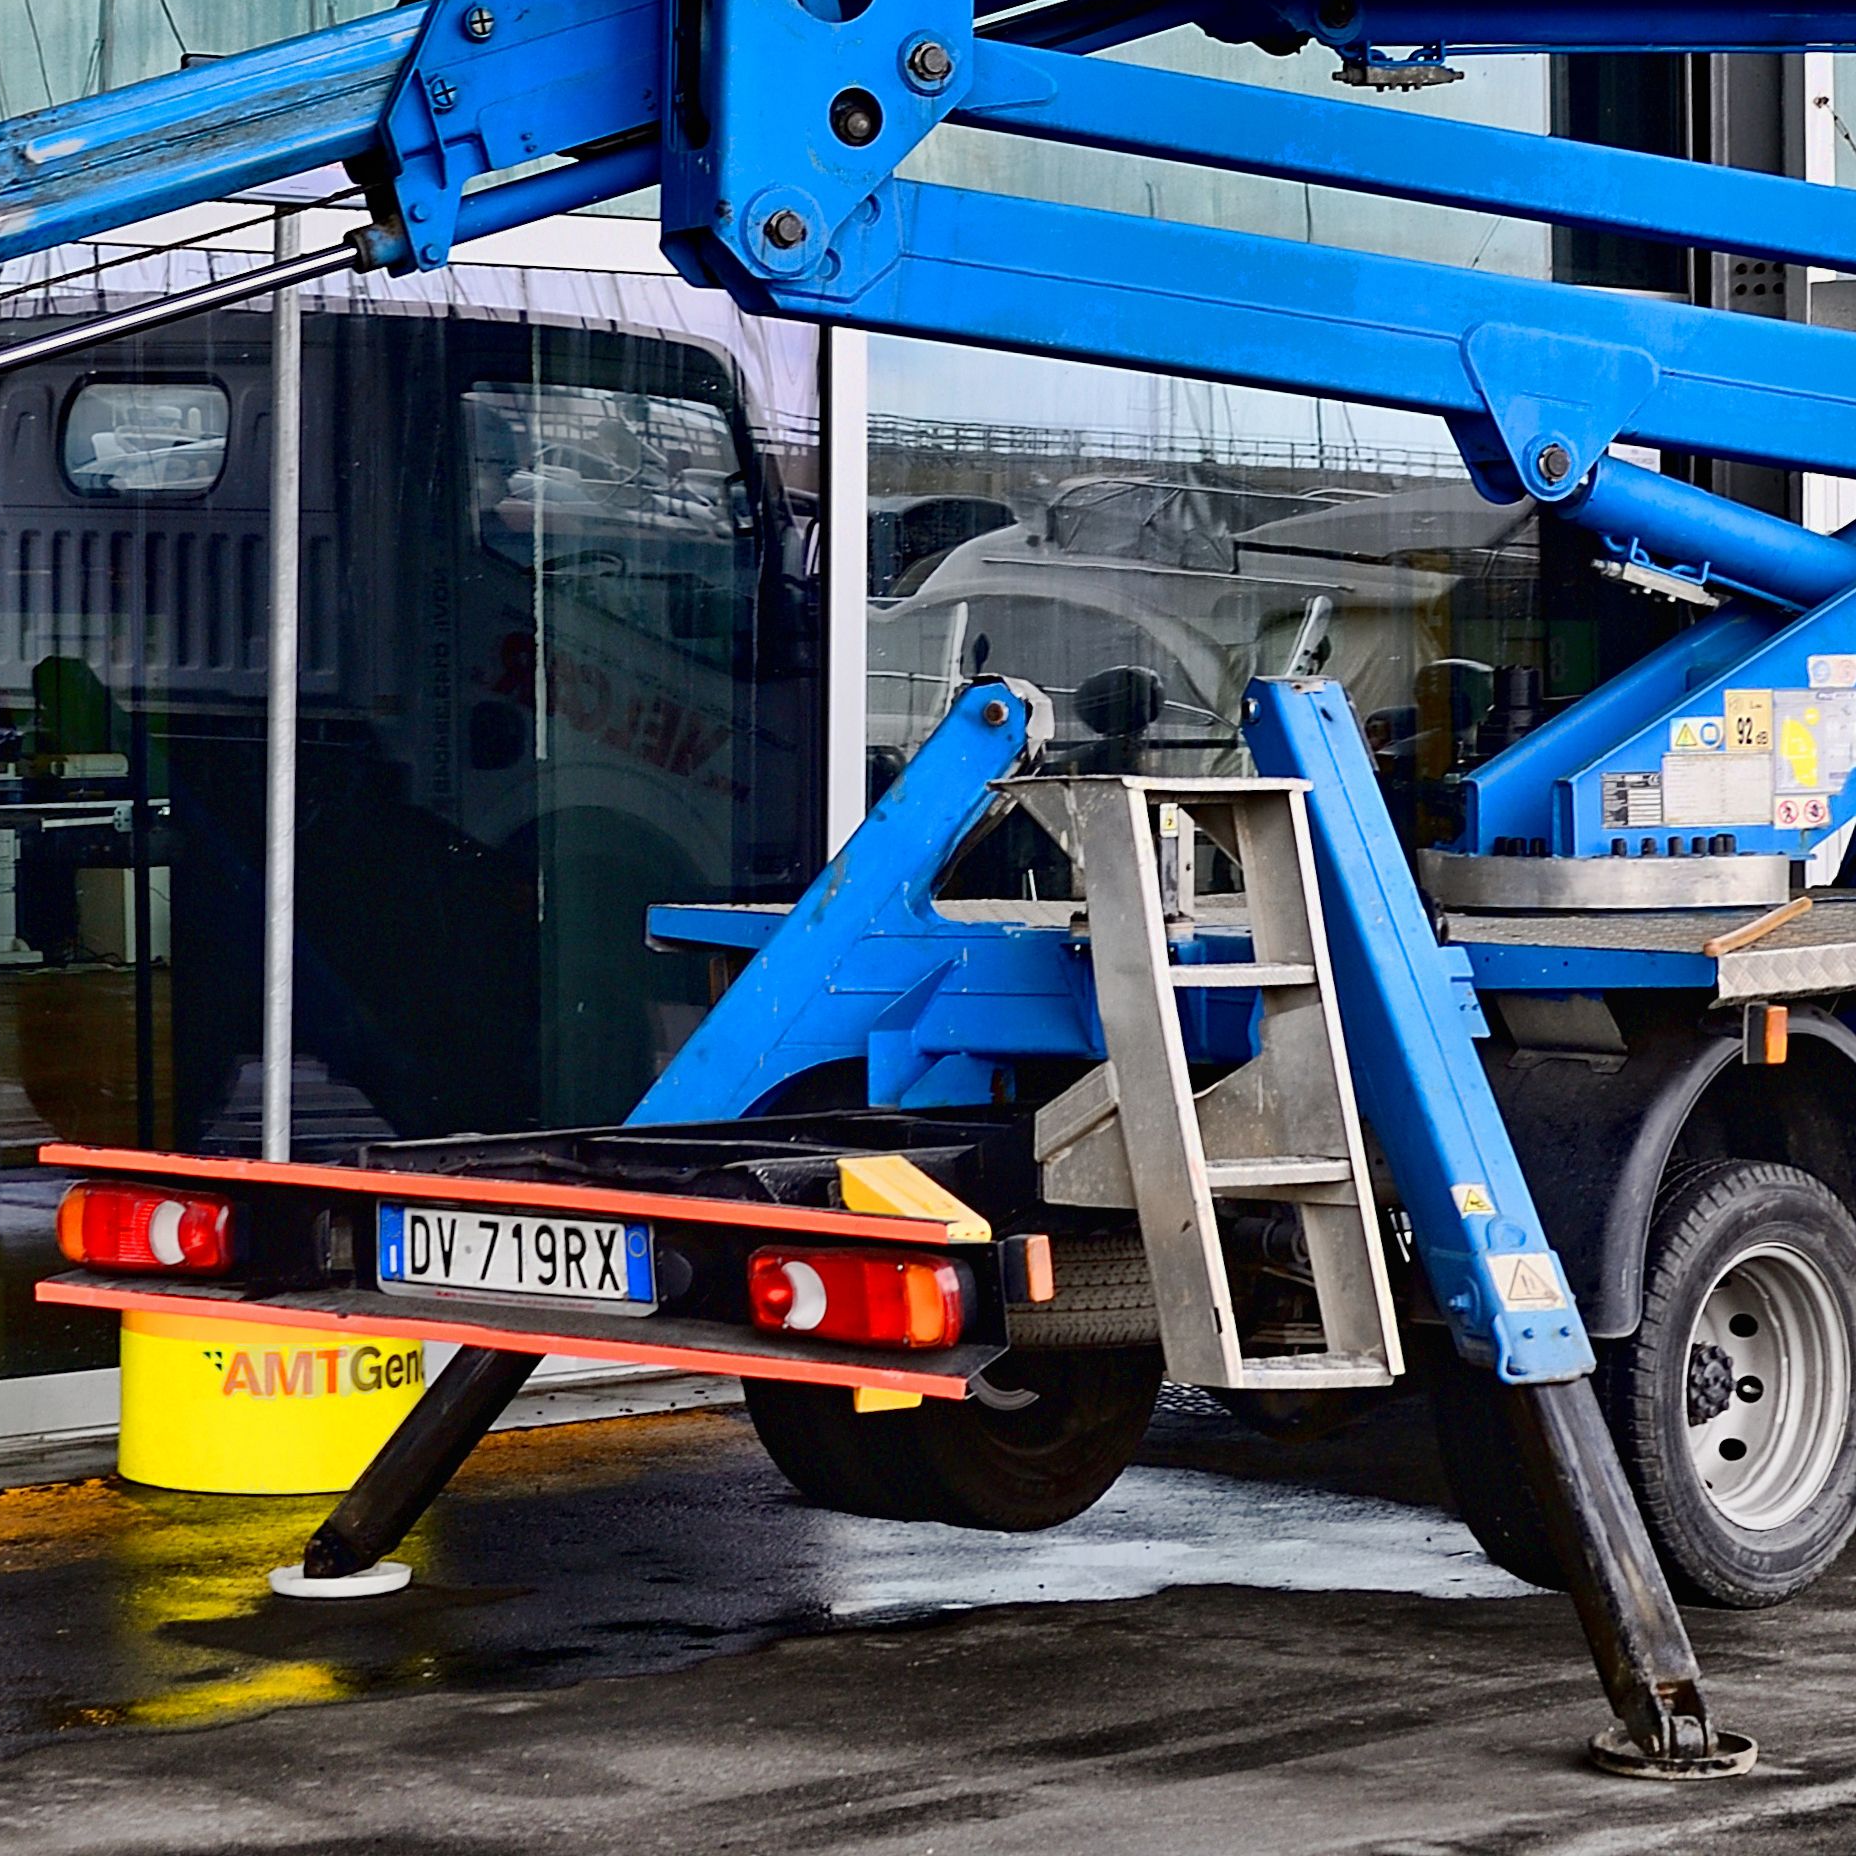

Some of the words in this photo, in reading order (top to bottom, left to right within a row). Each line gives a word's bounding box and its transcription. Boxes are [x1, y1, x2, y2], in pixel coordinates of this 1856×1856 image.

[1736, 716, 1753, 745] 92
[1756, 730, 1769, 745] dB
[410, 1214, 457, 1278] DV
[478, 1221, 621, 1292] 719RX
